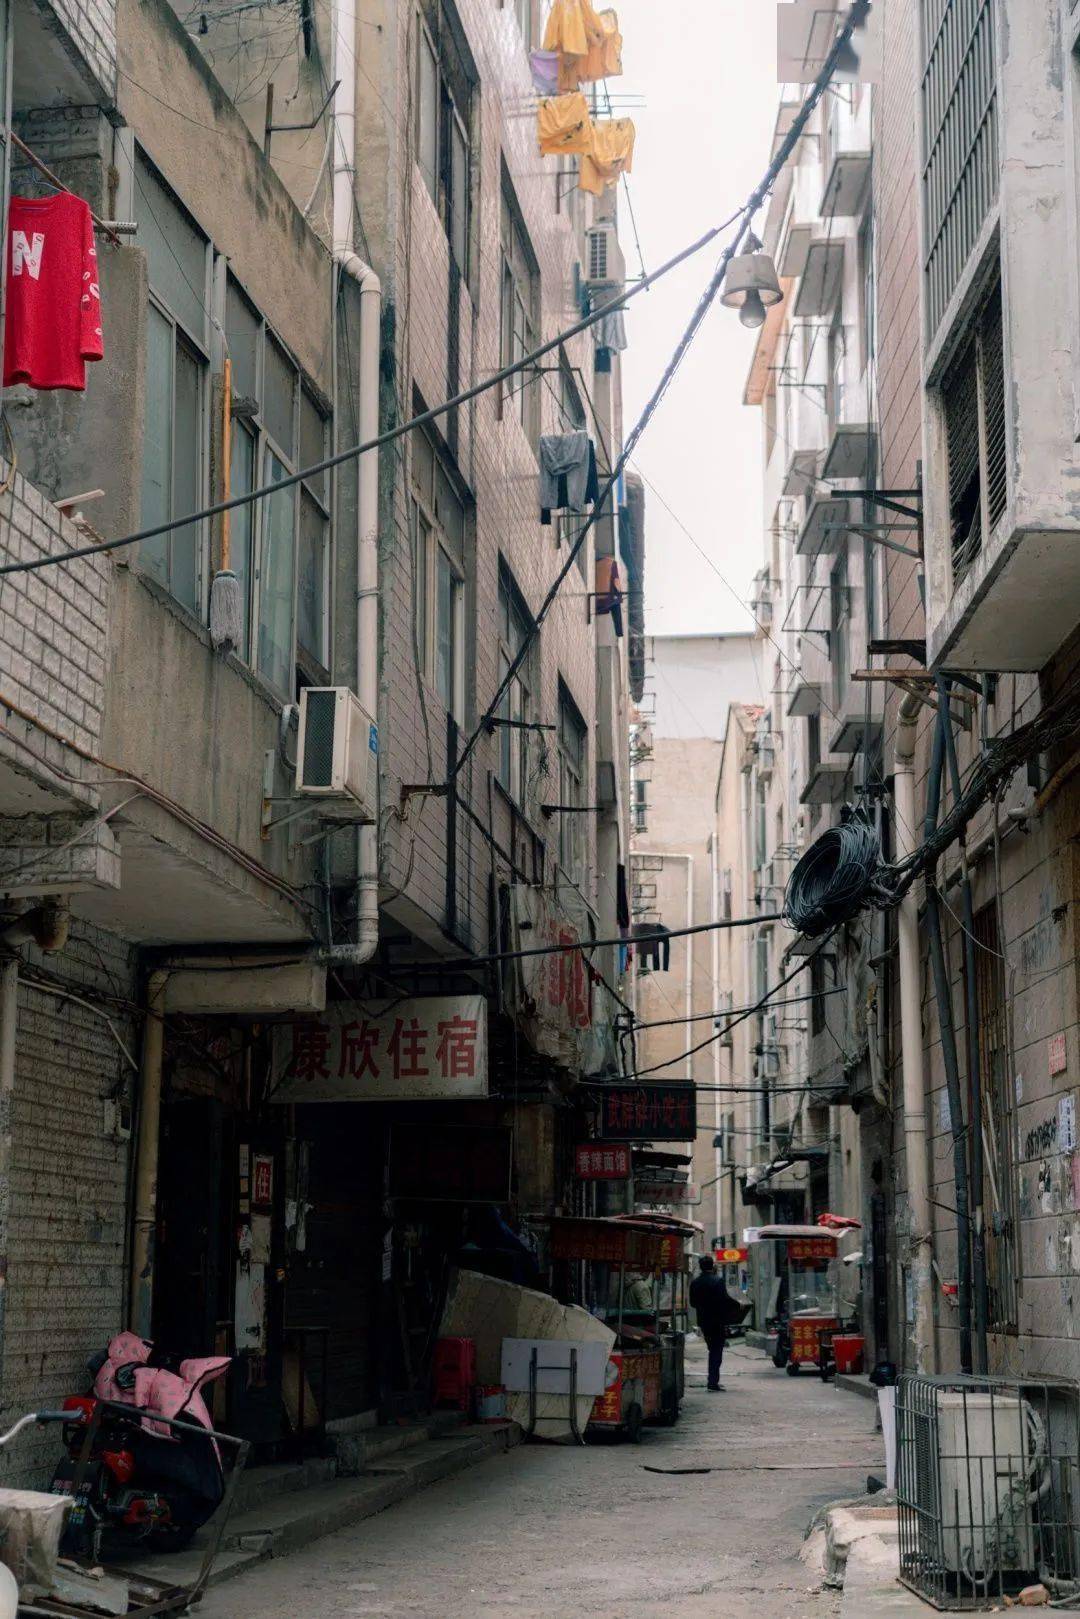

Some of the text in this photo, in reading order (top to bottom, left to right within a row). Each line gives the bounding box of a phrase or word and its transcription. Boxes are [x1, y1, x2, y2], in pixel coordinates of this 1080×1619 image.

[289, 1016, 477, 1080] 康欣住宿
[577, 1151, 626, 1173] 香辣面馆
